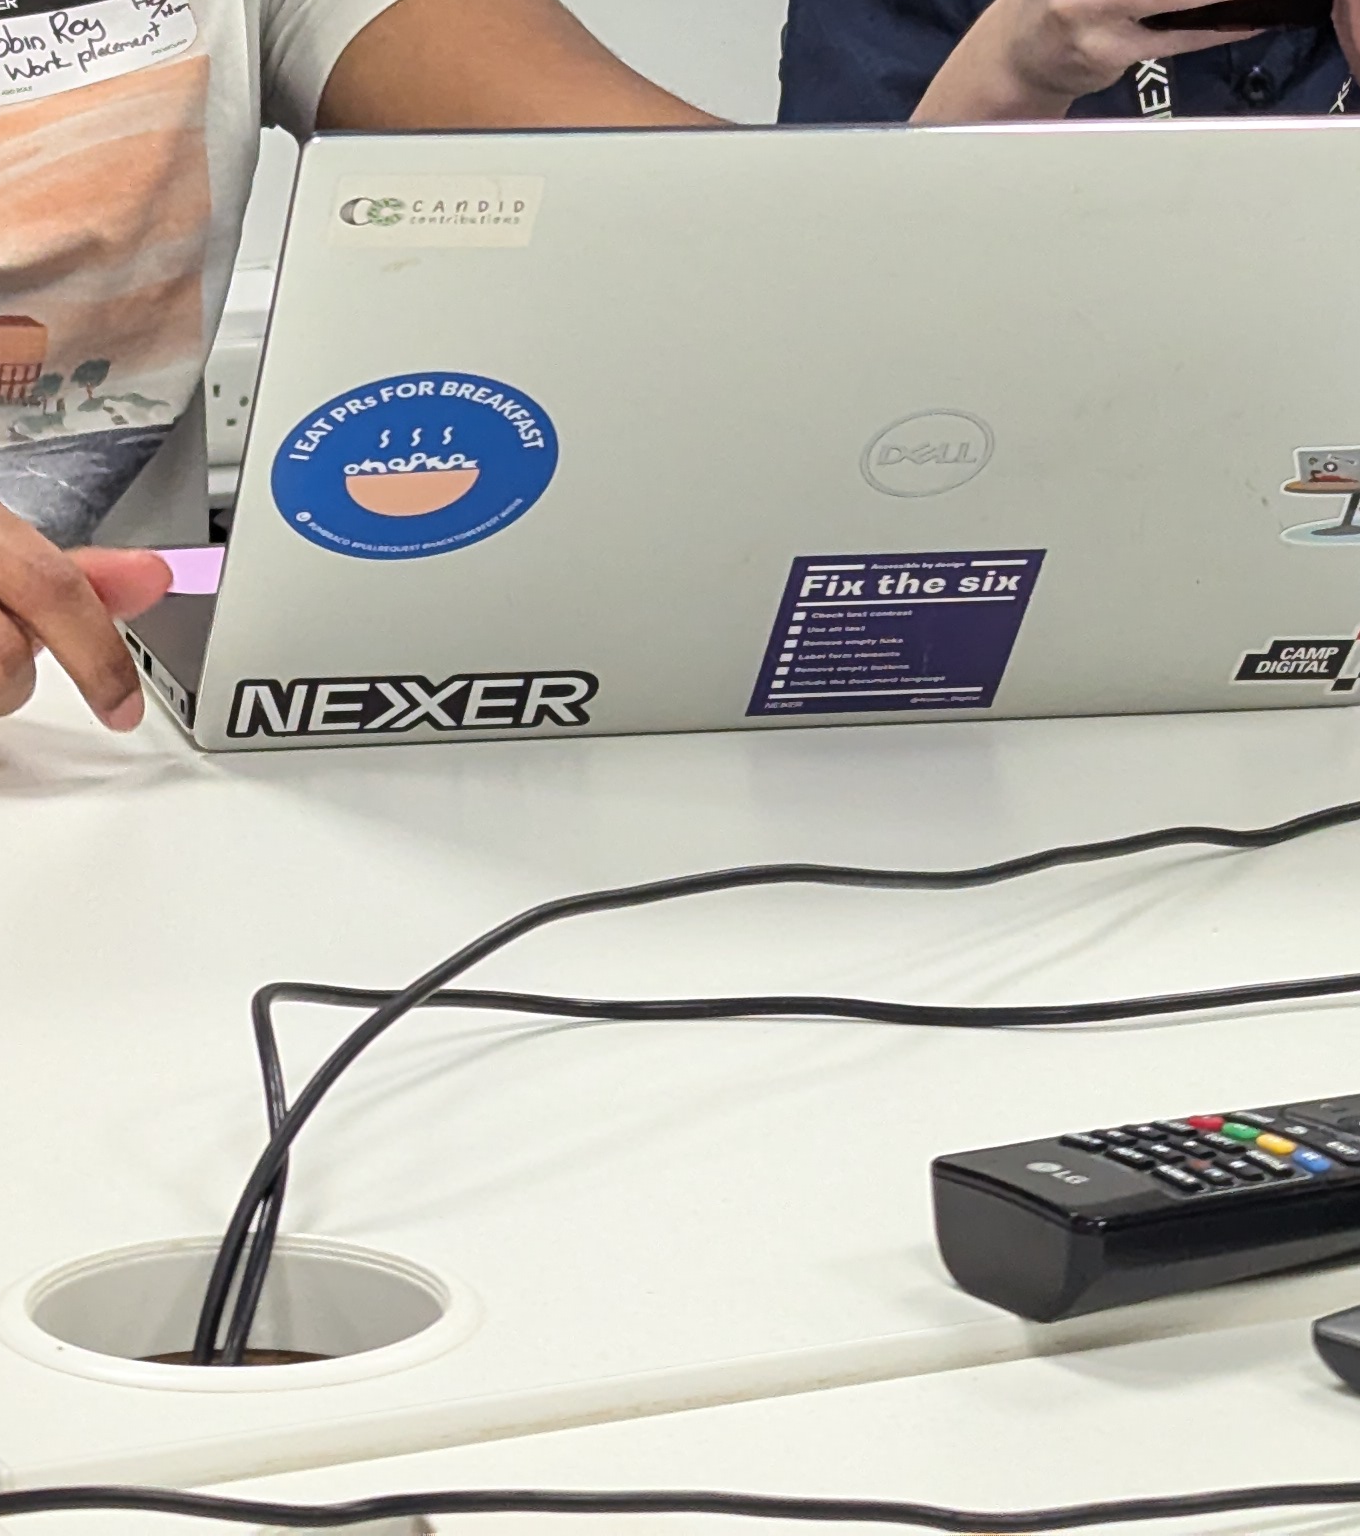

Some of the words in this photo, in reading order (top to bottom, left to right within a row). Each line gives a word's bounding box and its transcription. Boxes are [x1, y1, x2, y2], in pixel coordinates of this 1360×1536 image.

[49, 11, 107, 45] Roy
[3, 50, 73, 81] Work
[77, 22, 162, 73] placement
[409, 215, 521, 226] contributions
[379, 381, 435, 403] FOR
[330, 394, 378, 423] PRs
[440, 381, 545, 450] BREAKFAST
[294, 417, 334, 454] EAT
[289, 453, 310, 462] I
[876, 441, 978, 466] DELL
[799, 574, 866, 597] Fix
[878, 571, 947, 595] the
[957, 570, 1022, 593] six
[1255, 660, 1330, 674] DIGITAL
[1280, 647, 1340, 661] CAMP
[234, 676, 591, 734] NEXER
[1052, 1169, 1090, 1185] LG
